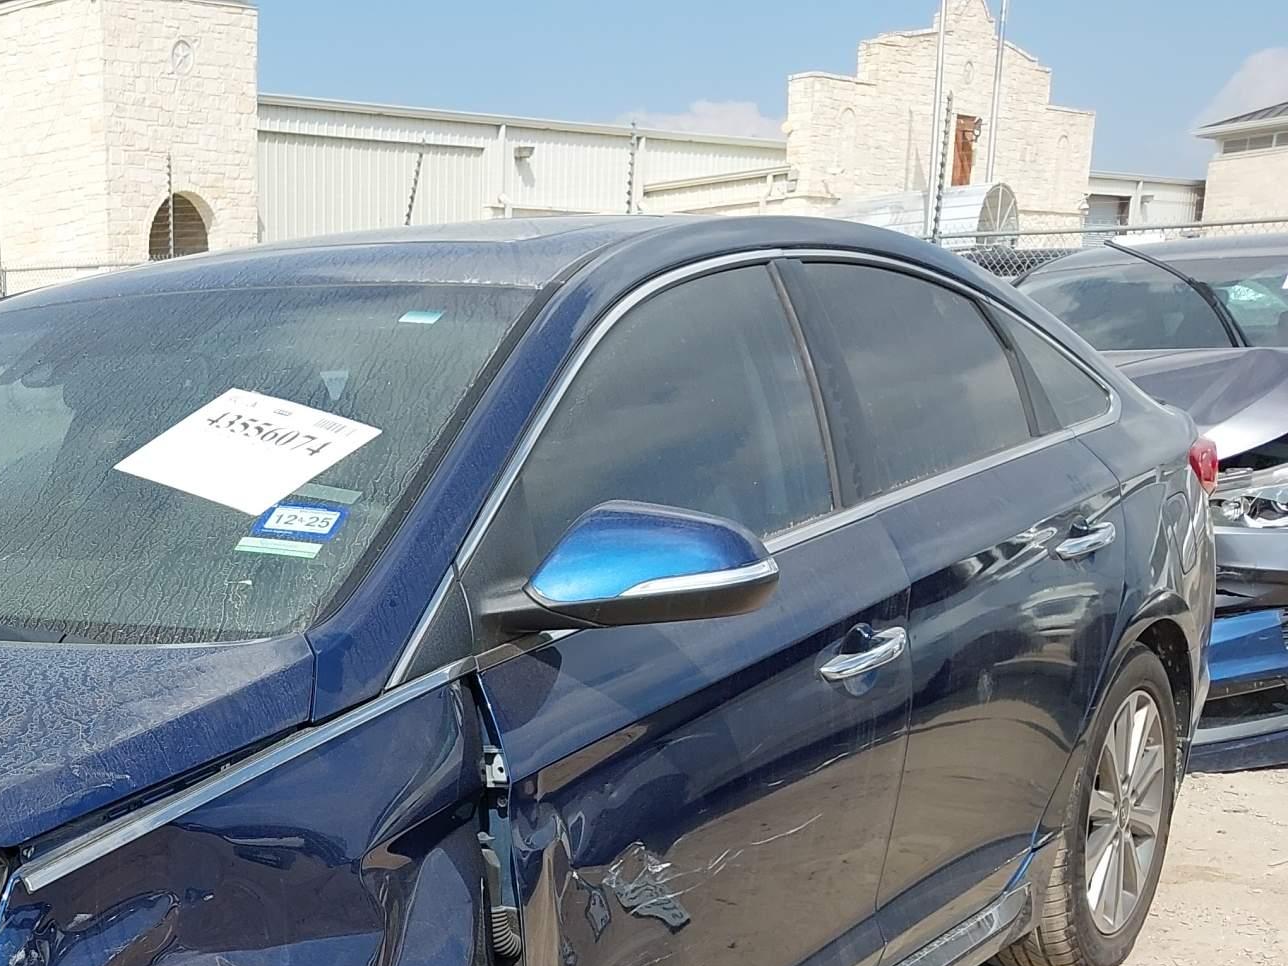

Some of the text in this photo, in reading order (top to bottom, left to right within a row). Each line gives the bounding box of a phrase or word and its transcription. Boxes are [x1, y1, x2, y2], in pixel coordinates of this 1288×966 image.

[207, 411, 332, 456] 43556074
[273, 513, 331, 529] 12 25
